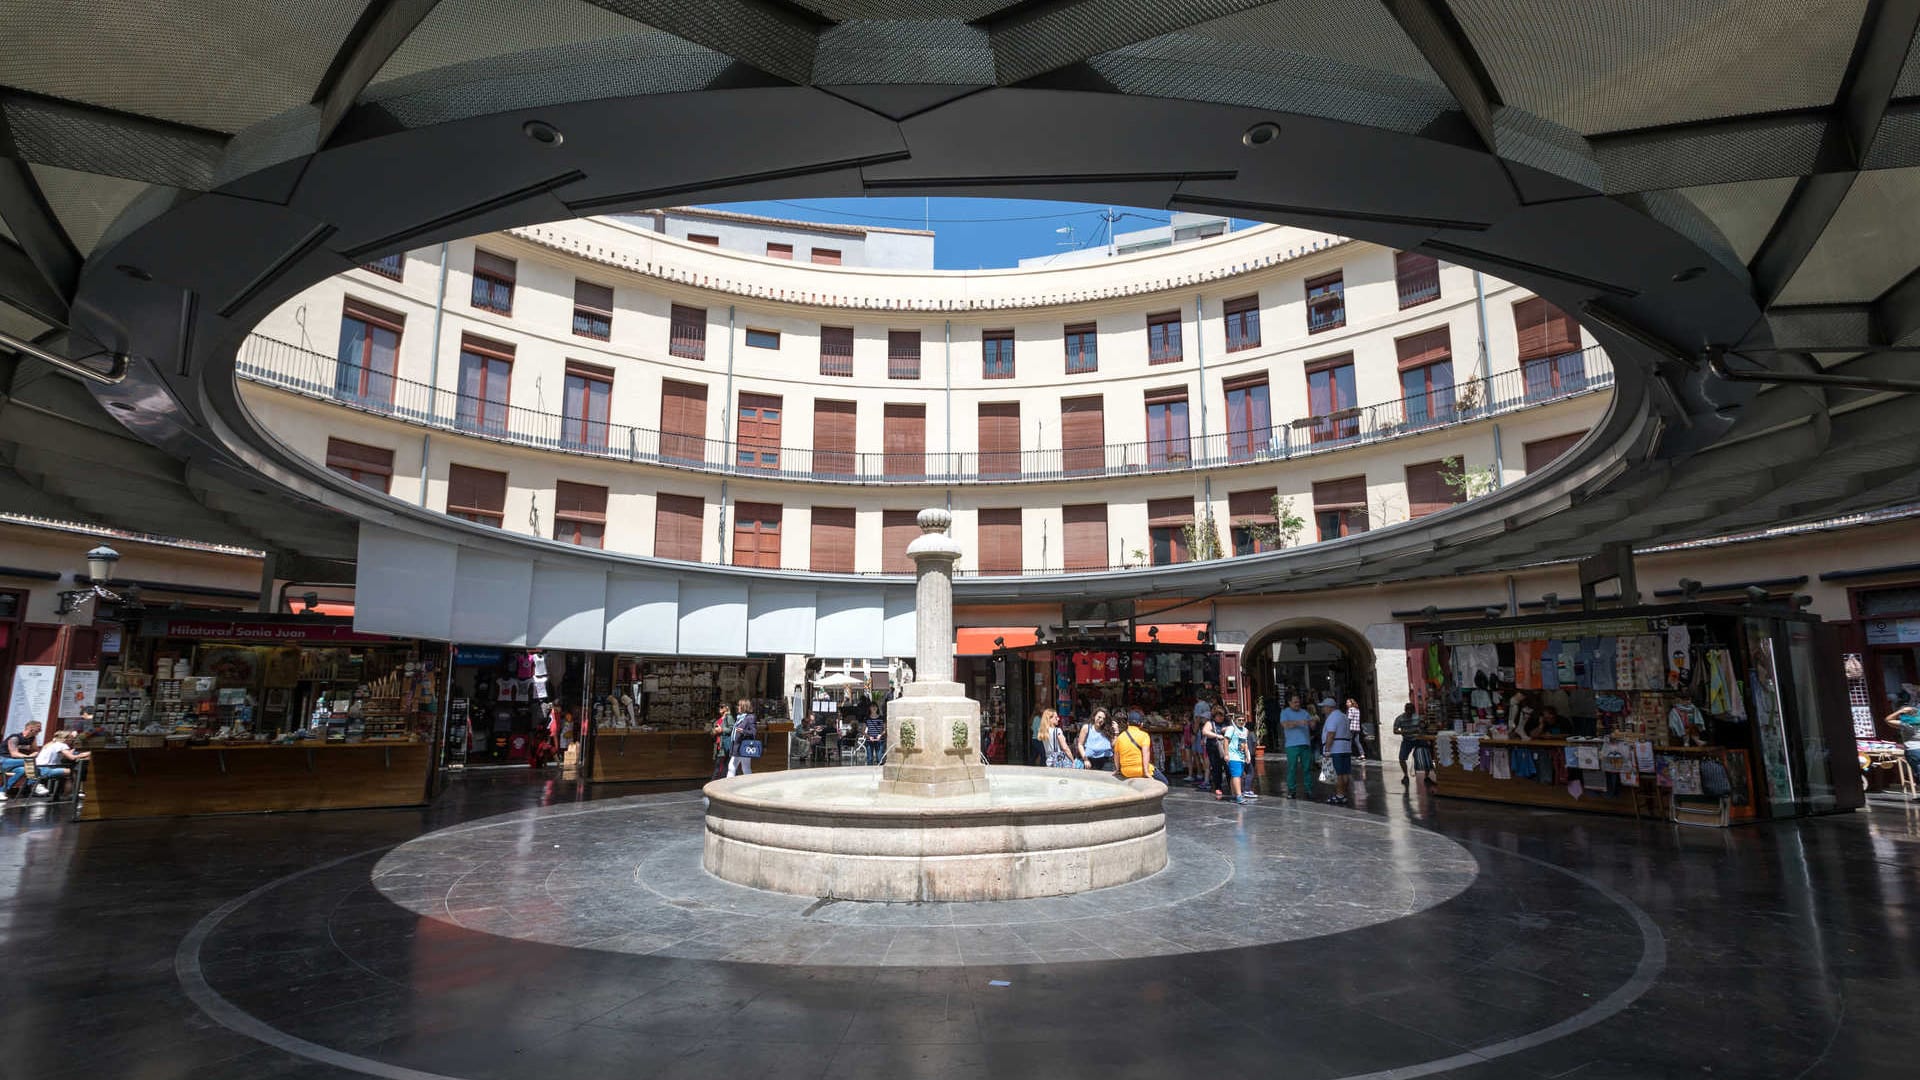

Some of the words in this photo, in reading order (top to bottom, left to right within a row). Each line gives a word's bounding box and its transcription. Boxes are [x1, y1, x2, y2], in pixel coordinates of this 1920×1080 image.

[170, 625, 232, 636] Hilaturas
[235, 627, 272, 637] Sonia
[275, 627, 306, 638] Juan
